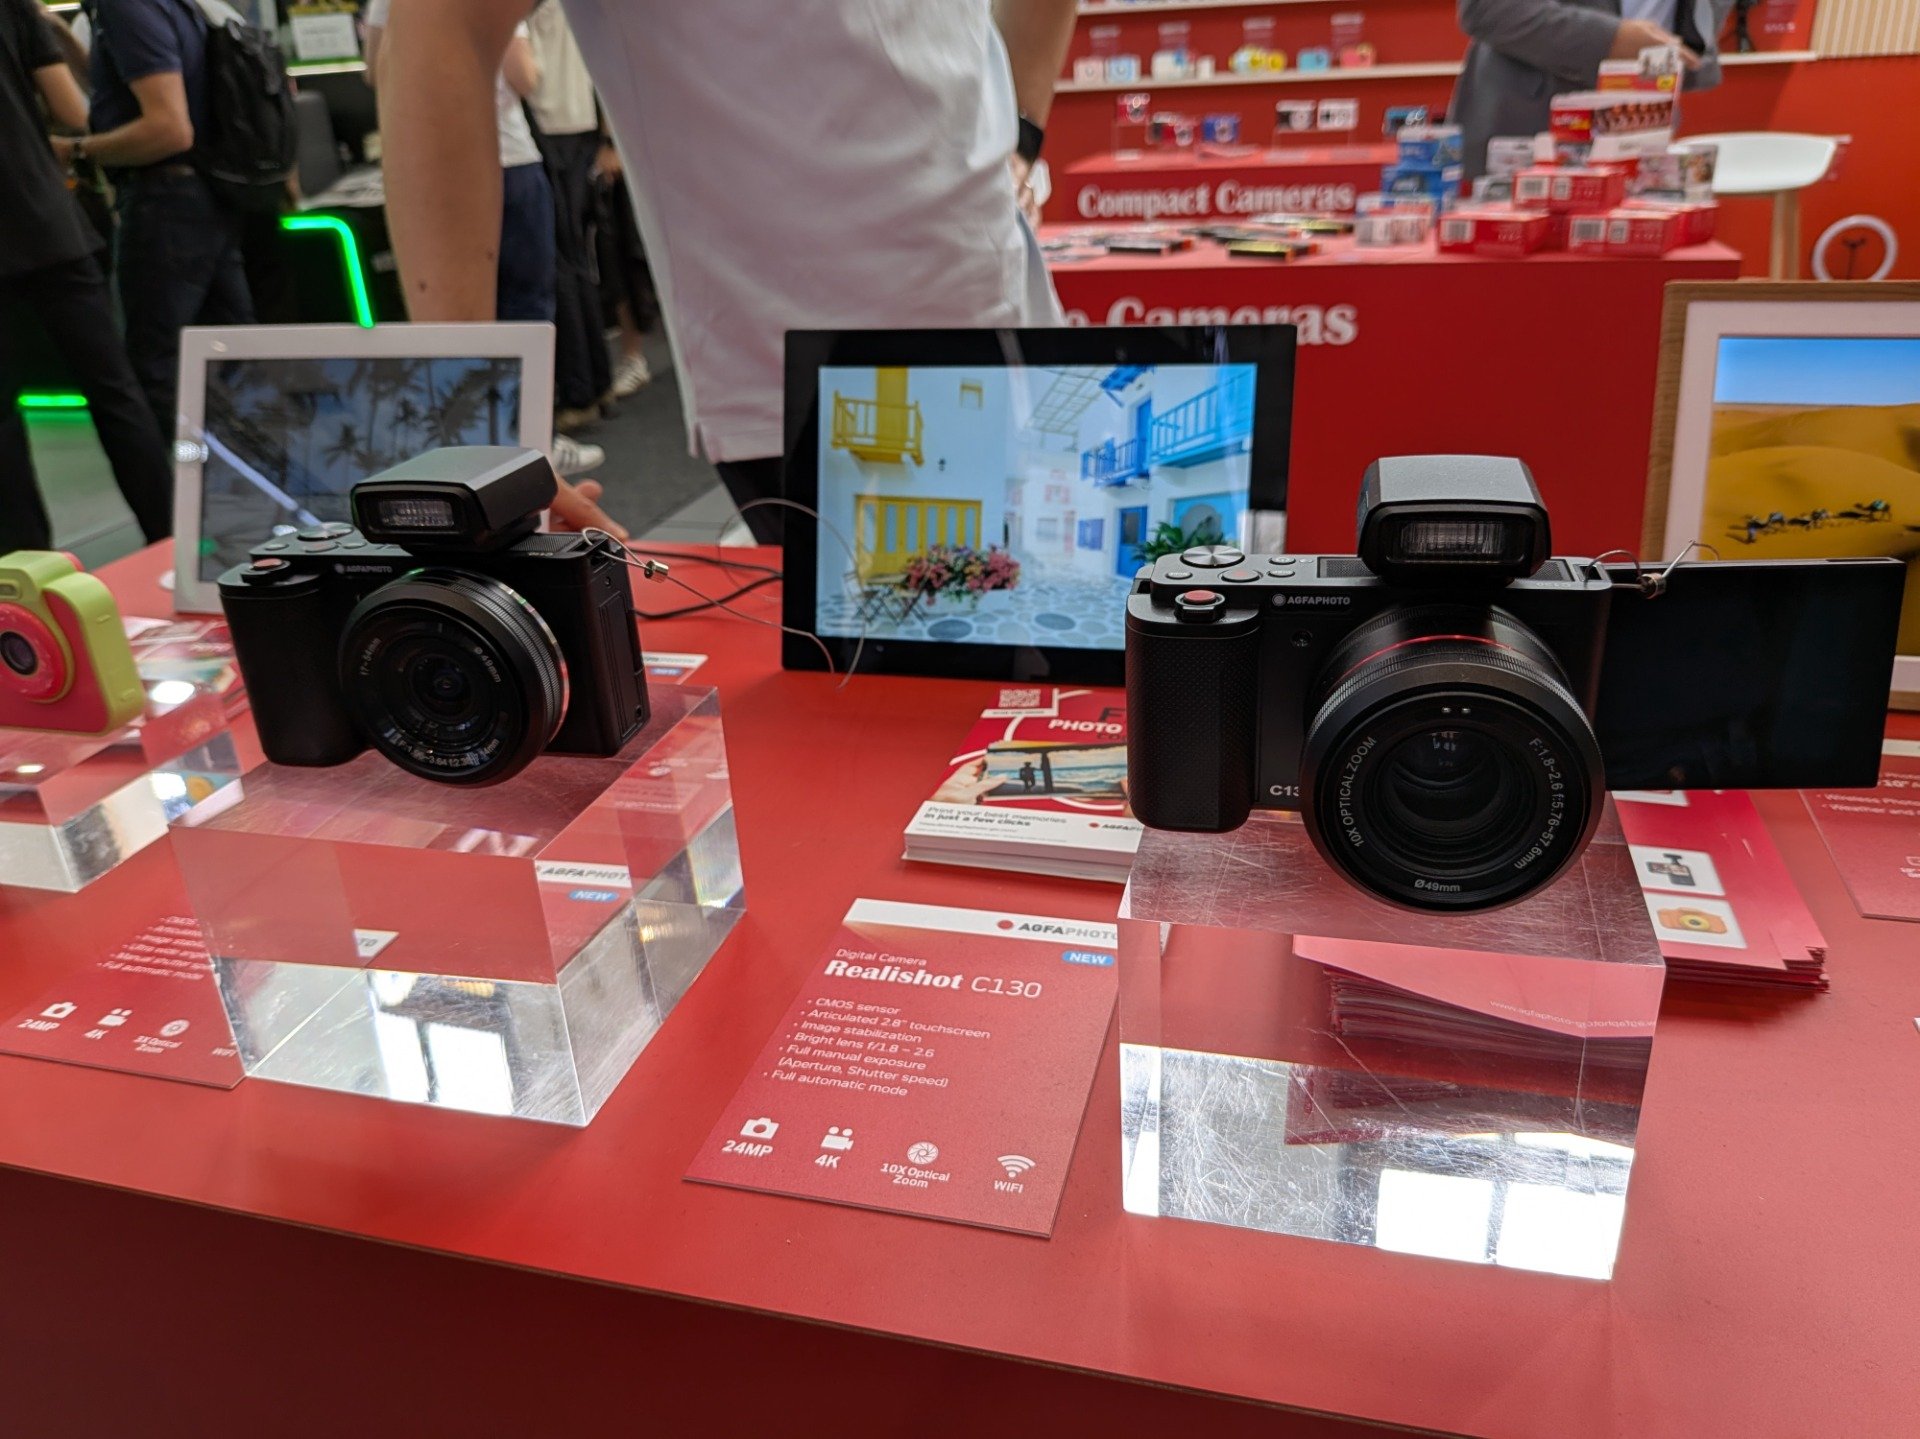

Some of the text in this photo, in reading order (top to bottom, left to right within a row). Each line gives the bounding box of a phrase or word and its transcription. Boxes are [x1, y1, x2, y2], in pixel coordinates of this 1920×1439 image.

[1078, 179, 1355, 221] Compact Cameras
[1287, 596, 1351, 605] AGFAPHOTO
[1048, 718, 1123, 734] PHOTO
[1340, 736, 1377, 847] 10X OPTICAL ZOOM
[574, 890, 611, 901] NEW
[835, 948, 927, 967] Digital Camera
[1069, 951, 1107, 965] NEW
[824, 959, 1043, 999] Realishot C130
[815, 997, 901, 1015] CMOS sensor
[17, 1019, 61, 1032] 24MP
[801, 1020, 922, 1043] Image stabilization
[807, 1009, 879, 1025] Articulated
[909, 1021, 991, 1039] touchscreen
[83, 1028, 110, 1040] 4K
[148, 1038, 184, 1049] Optical
[794, 1032, 835, 1047] Bright
[836, 1037, 864, 1049] lens
[867, 1041, 899, 1053] f/1.8
[913, 1048, 935, 1058] 2.6
[787, 1044, 927, 1071] Full manual exposure
[778, 1057, 949, 1088] (Aperture, Shutter speed)
[771, 1069, 908, 1097] Full automatic mode
[721, 1140, 774, 1158] 24MP
[814, 1153, 842, 1169] 4K
[880, 1162, 951, 1182] 10X Optical
[892, 1174, 930, 1189] Zoom
